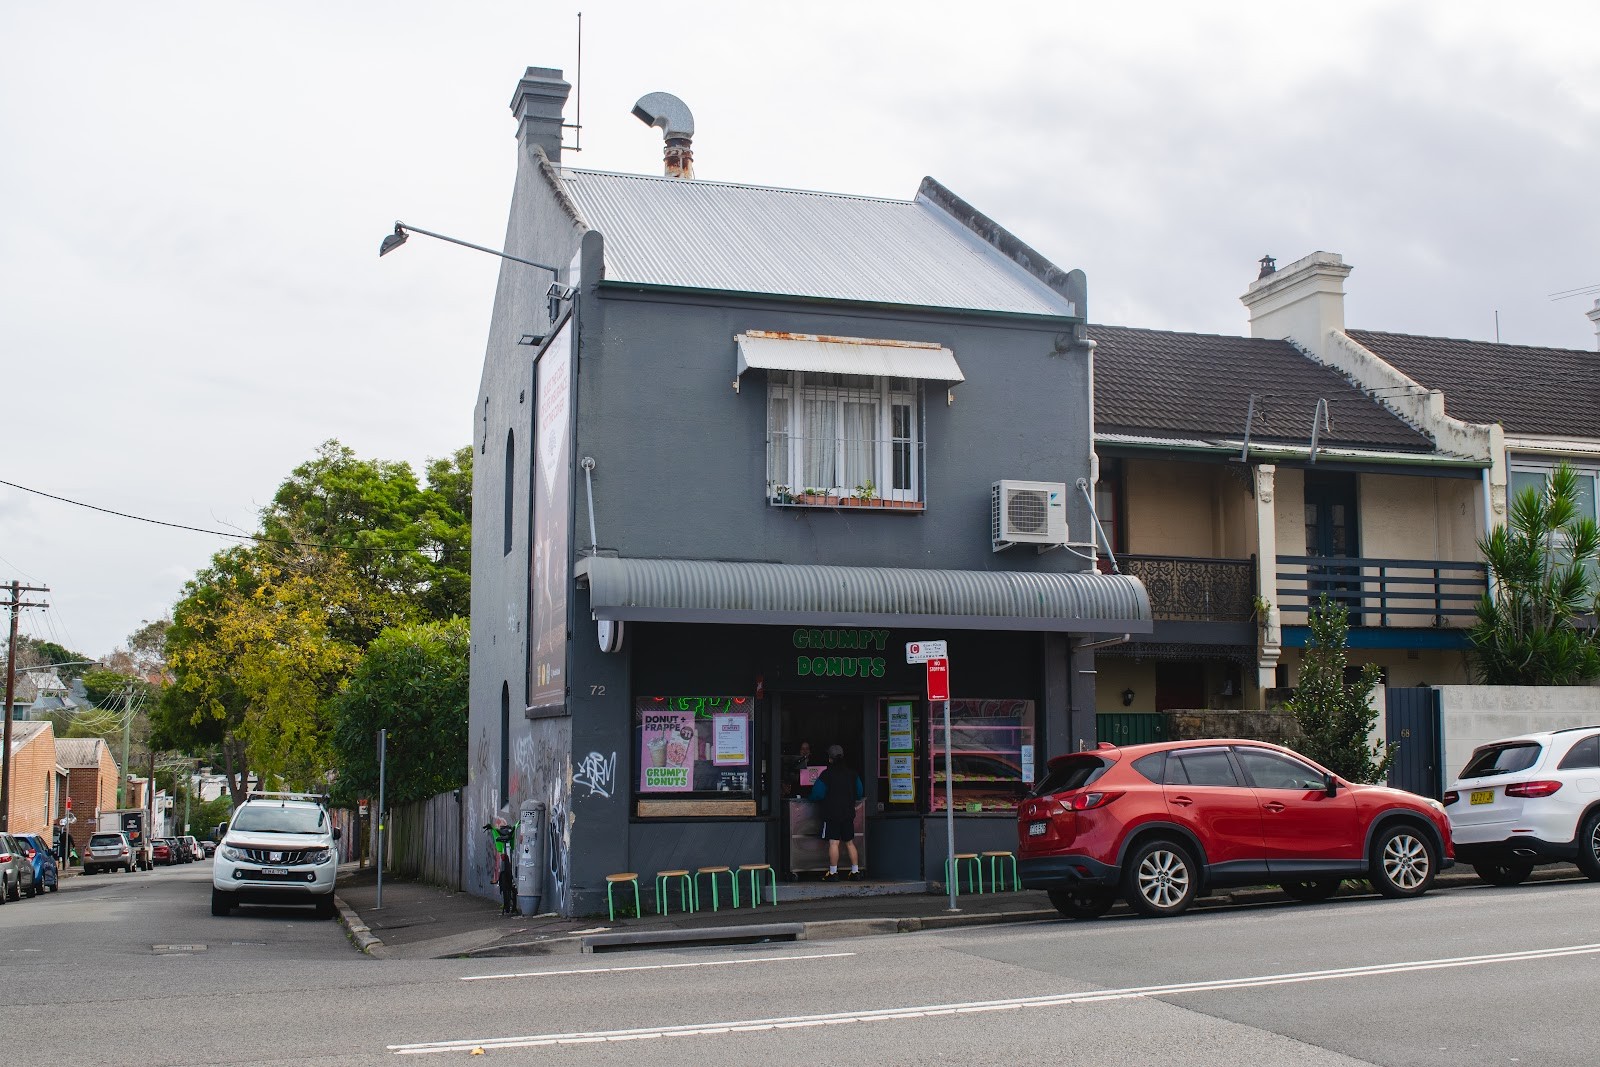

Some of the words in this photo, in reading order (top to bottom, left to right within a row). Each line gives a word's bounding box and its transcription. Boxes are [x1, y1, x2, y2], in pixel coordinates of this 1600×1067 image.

[793, 629, 889, 651] GRUMPY
[797, 656, 885, 678] DONUTS
[589, 684, 606, 696] 72
[645, 715, 679, 724] DONUT
[645, 723, 681, 732] FRAPPE
[1114, 723, 1129, 735] 70
[1400, 728, 1411, 738] 68
[645, 768, 689, 778] GRUMPY
[646, 777, 687, 786] DONUTS
